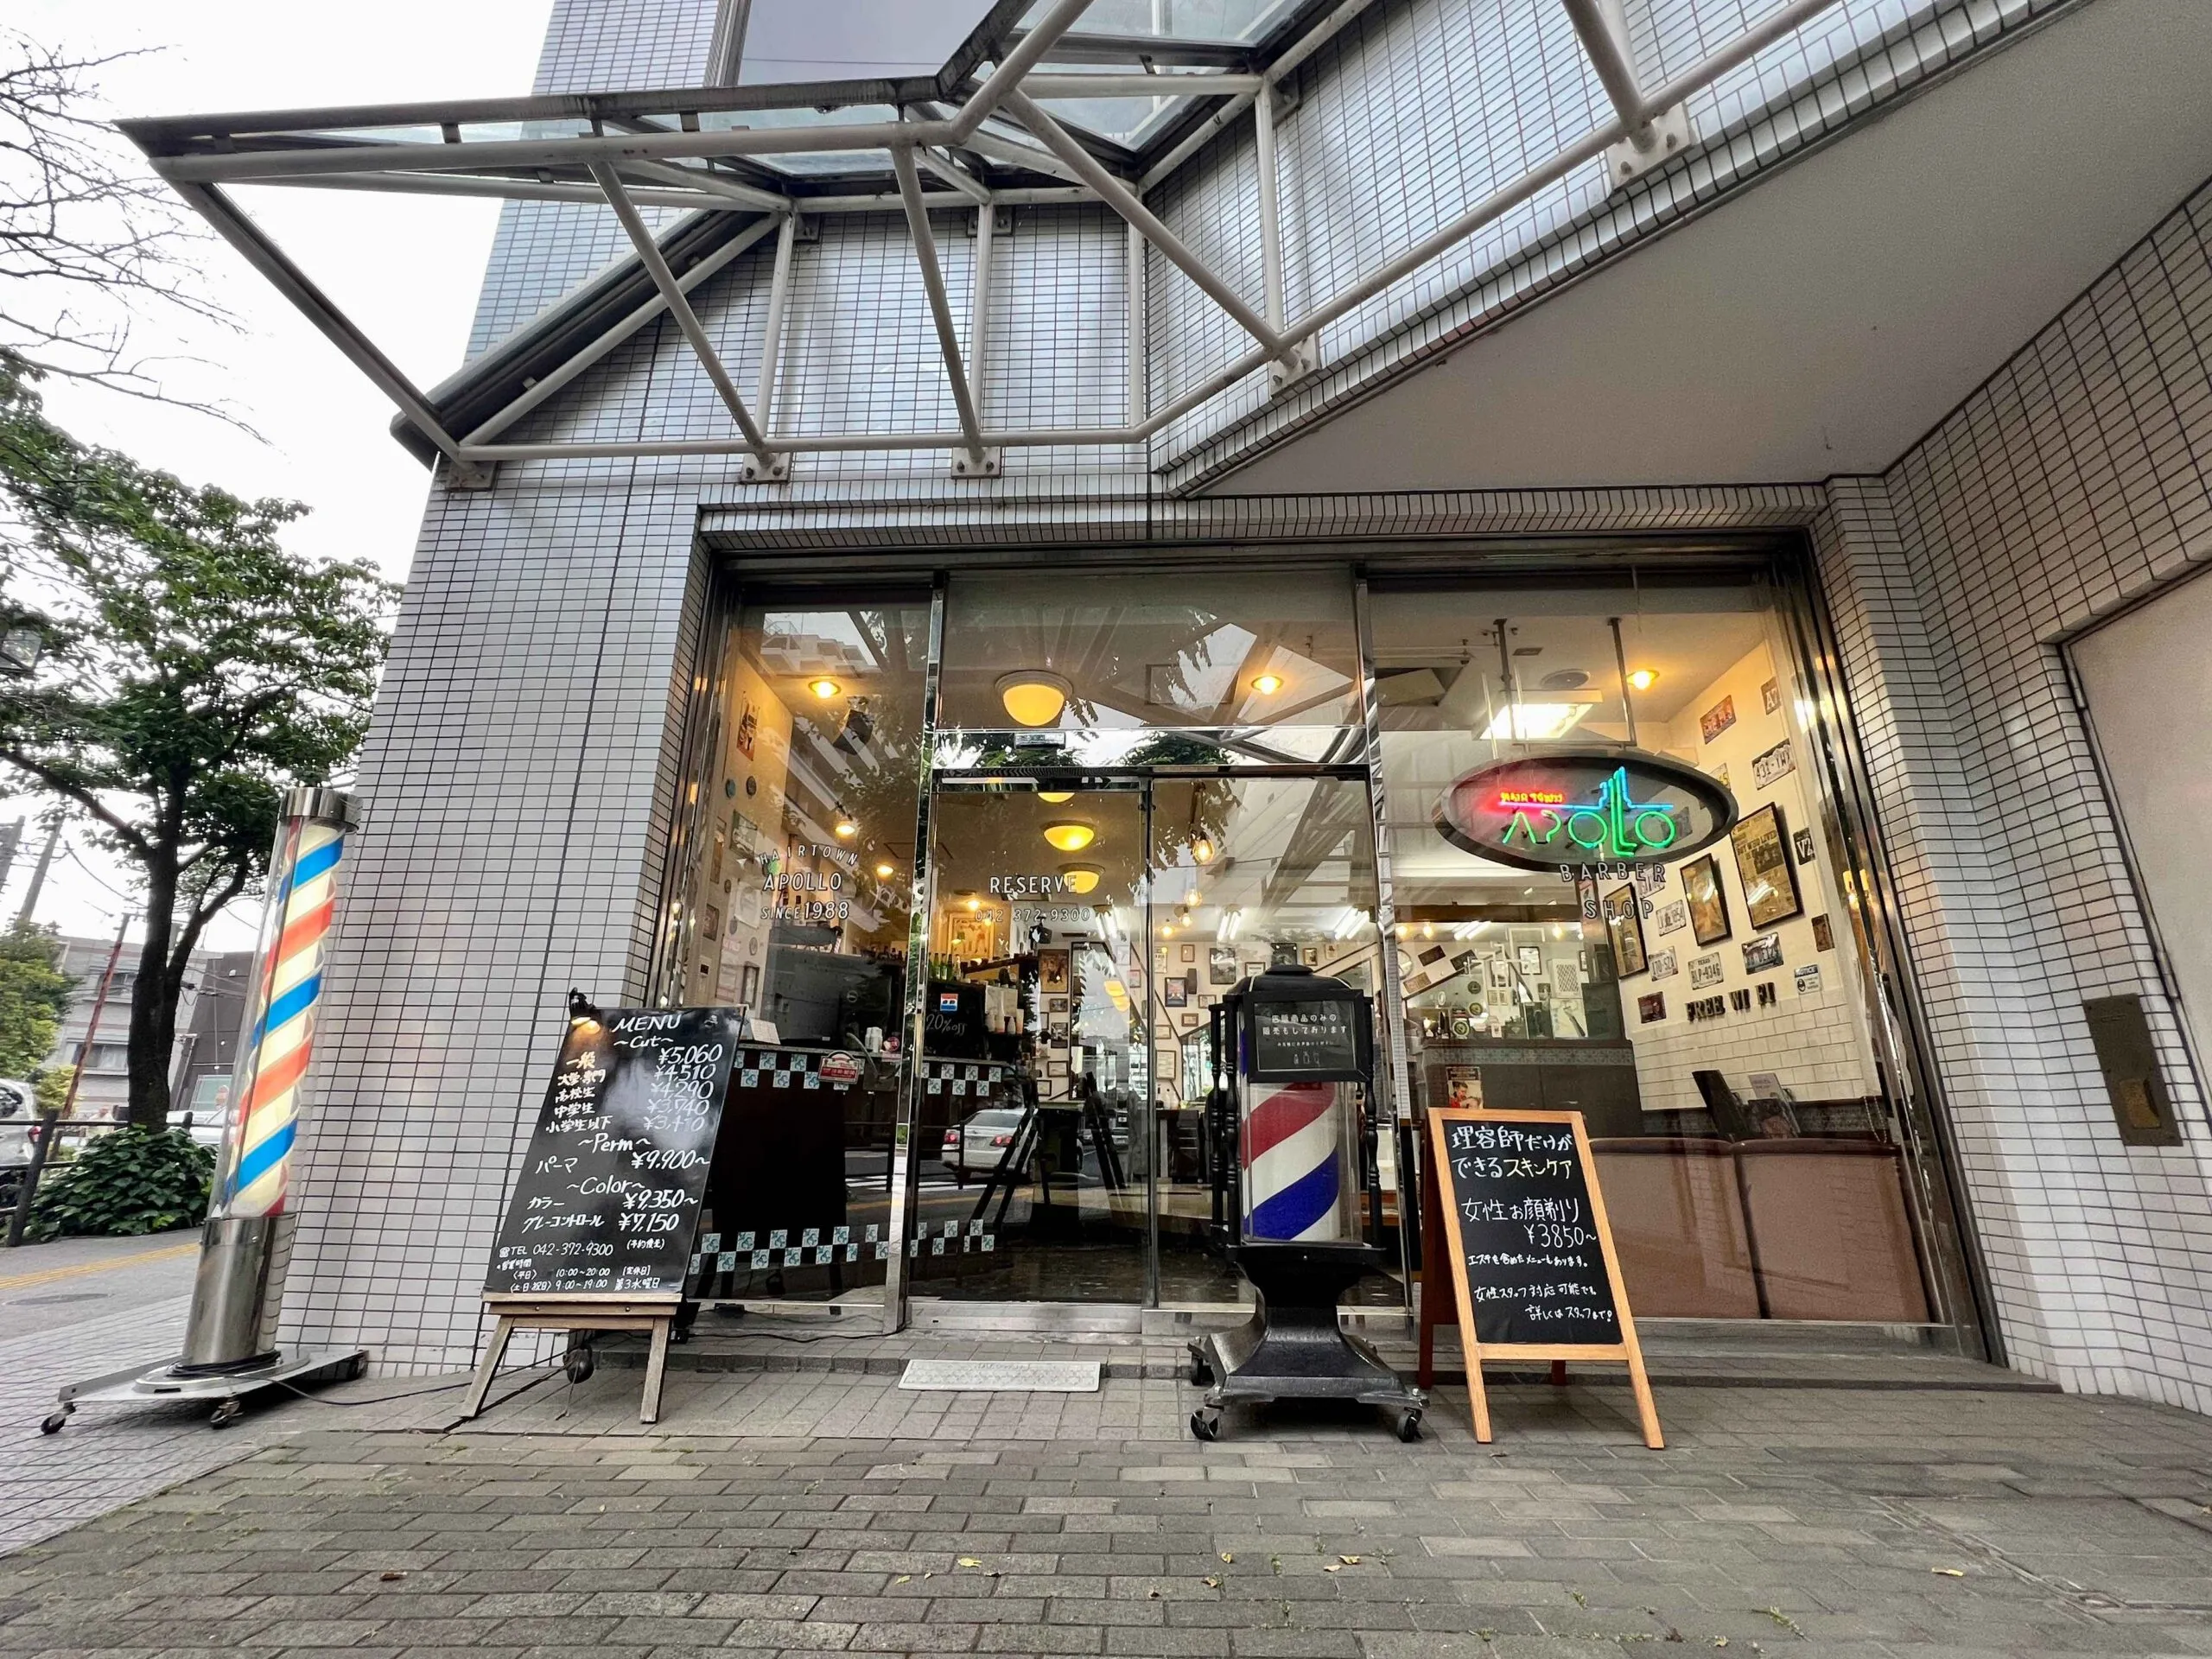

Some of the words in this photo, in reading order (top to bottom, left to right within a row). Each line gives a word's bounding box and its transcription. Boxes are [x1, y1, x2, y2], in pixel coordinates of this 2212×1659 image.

[1502, 767, 1676, 857] APOLLO
[760, 843, 858, 866] HAIRTOWN
[762, 872, 842, 891] APOLLO
[1560, 861, 1666, 882] BARBER
[989, 874, 1077, 894] RESERVE
[760, 906, 801, 919] SINCE
[804, 901, 849, 919] 1988
[975, 909, 1004, 922] 042
[1014, 908, 1042, 922] 372
[1050, 907, 1090, 922] 9300
[1585, 899, 1654, 919] SHOP
[1686, 995, 1726, 1020] FREE
[612, 1014, 682, 1033] MENU
[566, 1051, 596, 1070] 一般
[658, 1043, 723, 1065] ¥5,060
[654, 1064, 716, 1082] ¥4,510
[555, 1086, 596, 1104] 高校生
[651, 1080, 714, 1100] ¥4,290
[554, 1102, 596, 1119] 中学生
[545, 1115, 613, 1134] 小学生以下
[1451, 1125, 1574, 1152] 理容師だけが
[535, 1155, 579, 1173] パーマ
[1452, 1156, 1572, 1179] できるスキンケア
[526, 1196, 565, 1210] カラー
[618, 1212, 680, 1233] ¥7,150
[511, 1246, 528, 1255] TEL
